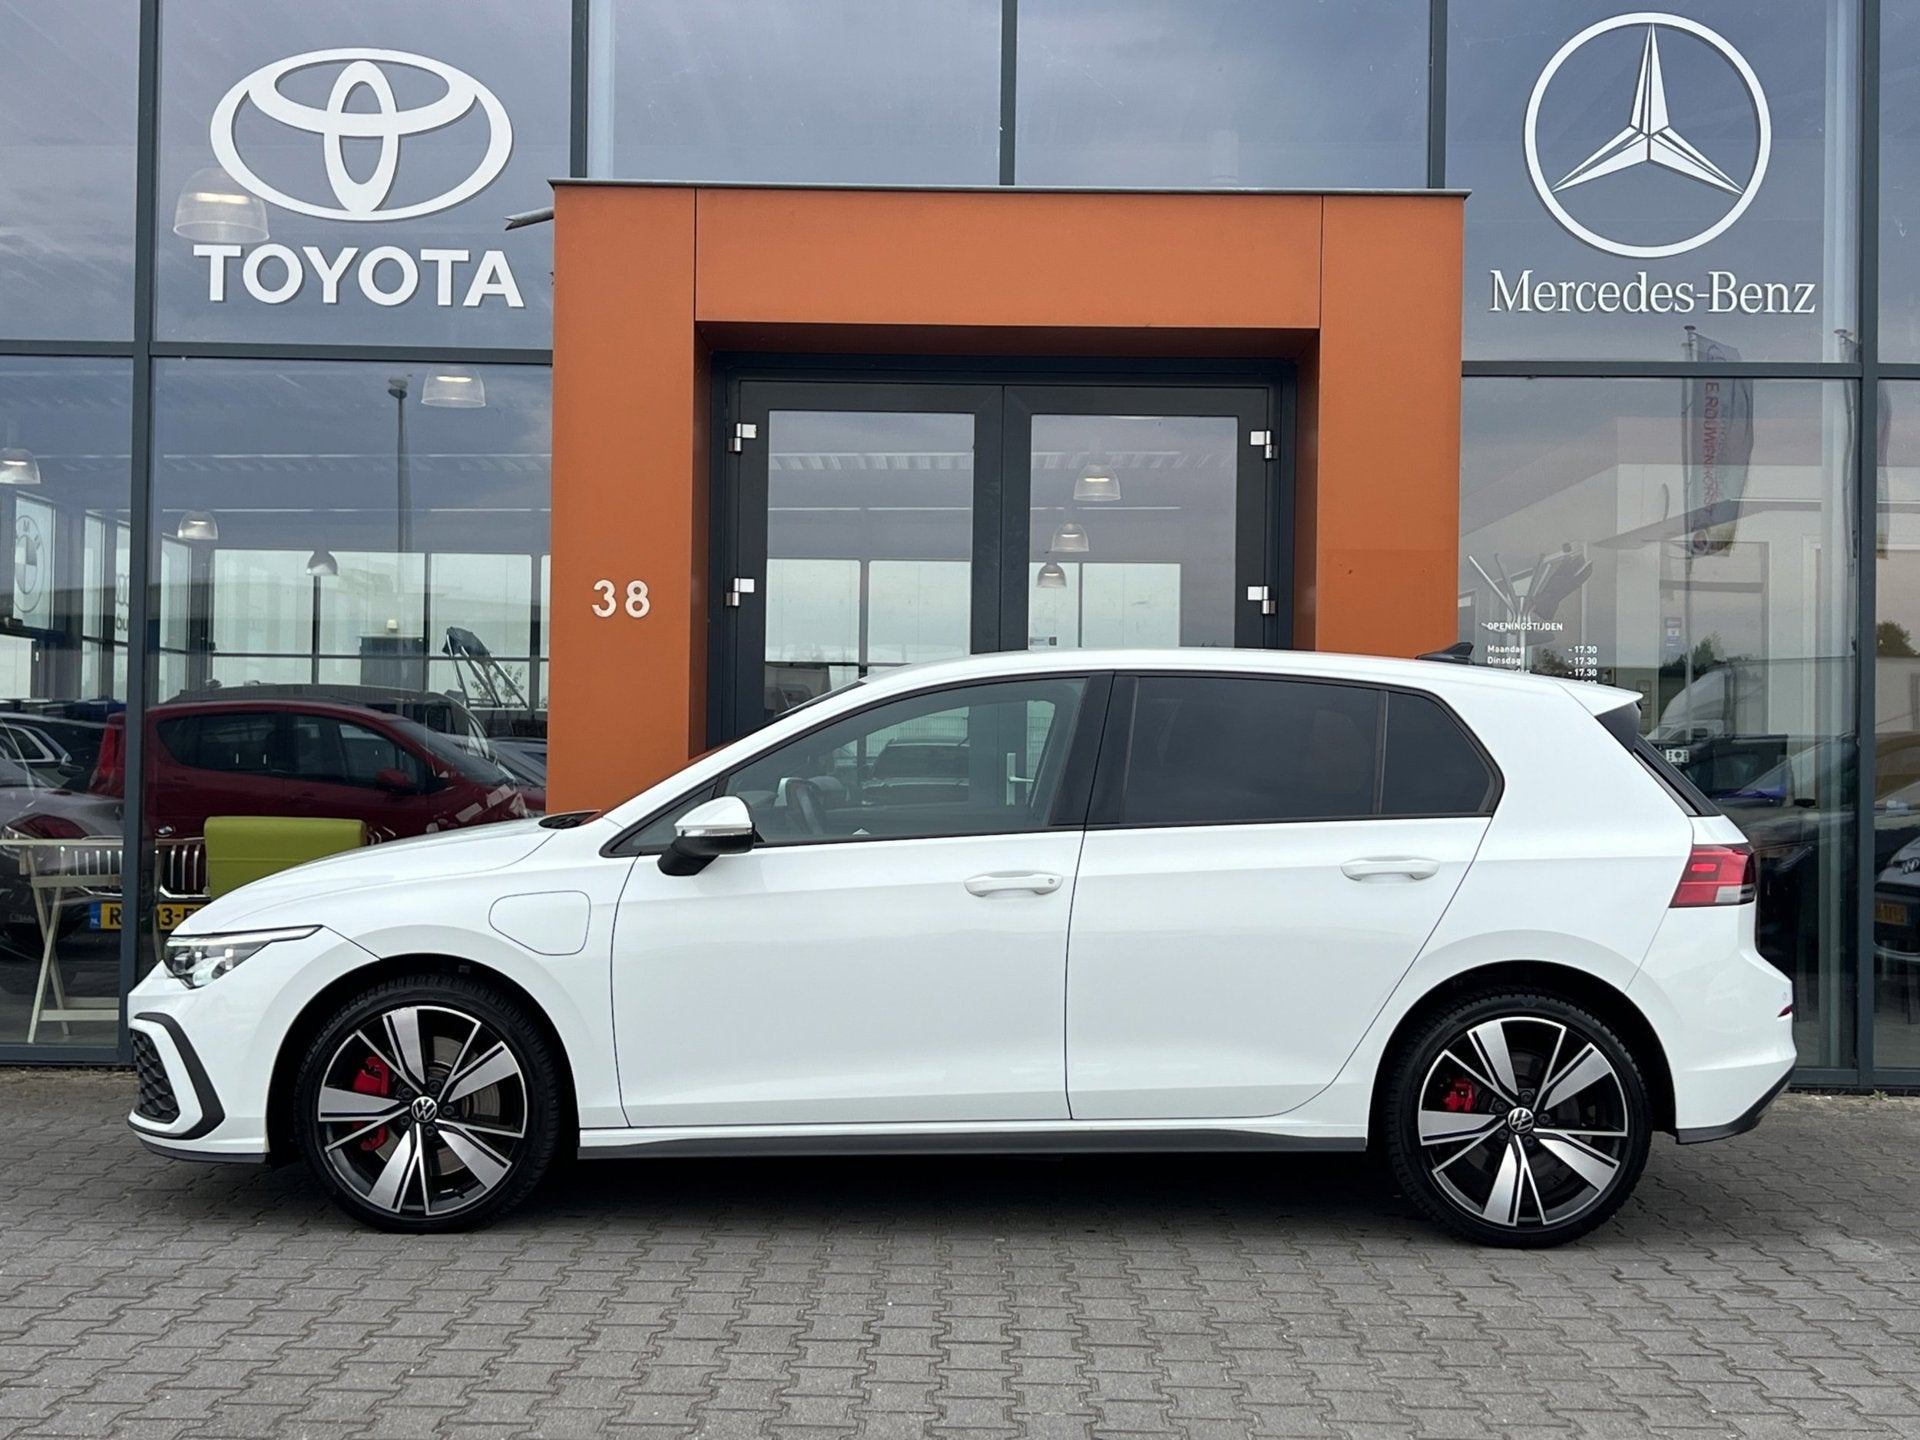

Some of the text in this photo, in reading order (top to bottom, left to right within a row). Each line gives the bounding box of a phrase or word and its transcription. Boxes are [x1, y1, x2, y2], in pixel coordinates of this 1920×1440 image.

[193, 243, 525, 307] TOYOTA
[1489, 269, 1816, 314] Mercedes-Benz
[591, 579, 650, 618] 38
[1487, 622, 1563, 631] OPENINGSTIJDEN
[1487, 645, 1525, 655] Maandag
[1574, 645, 1597, 654] 17.30
[1487, 656, 1521, 666] Dinsdag
[1574, 657, 1597, 665] 17.30
[1574, 668, 1597, 677] 17.30
